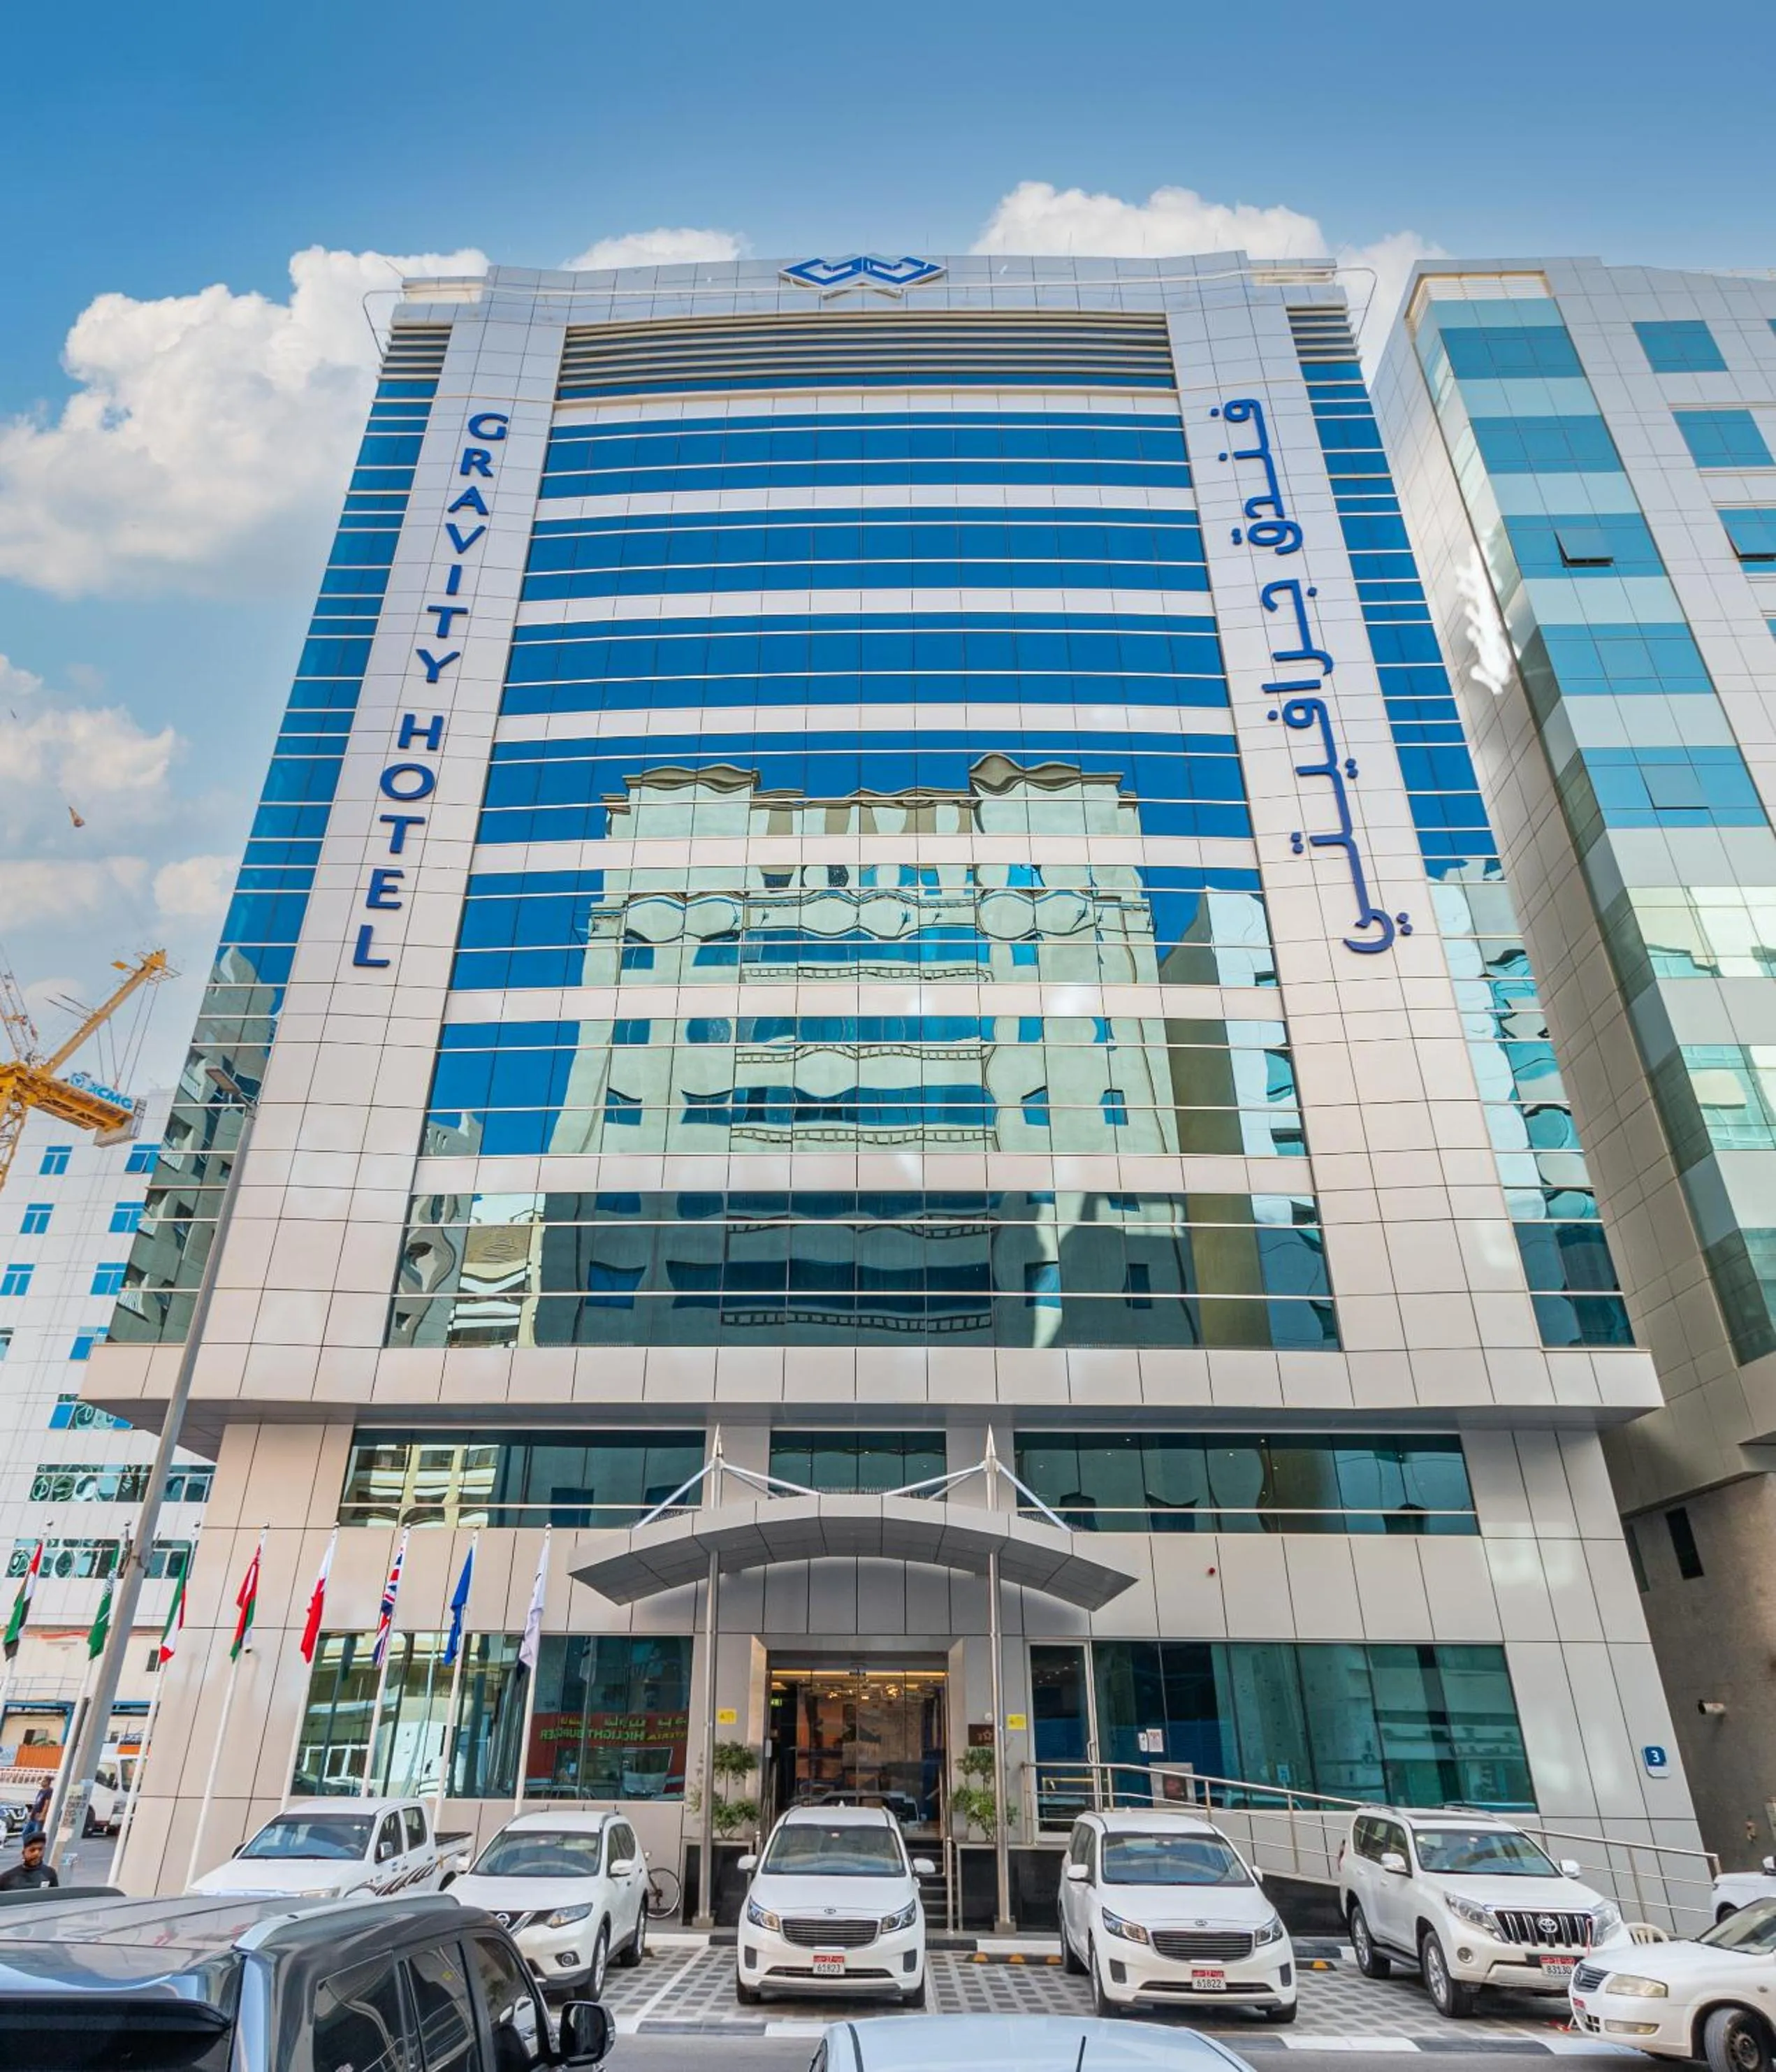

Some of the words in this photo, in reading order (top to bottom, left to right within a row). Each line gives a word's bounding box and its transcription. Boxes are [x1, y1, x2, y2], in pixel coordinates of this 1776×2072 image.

[416, 412, 509, 683] GRAVITY
[1210, 398, 1303, 556] فندق
[353, 713, 444, 967] HOTEL
[1651, 1750, 1660, 1762] 3
